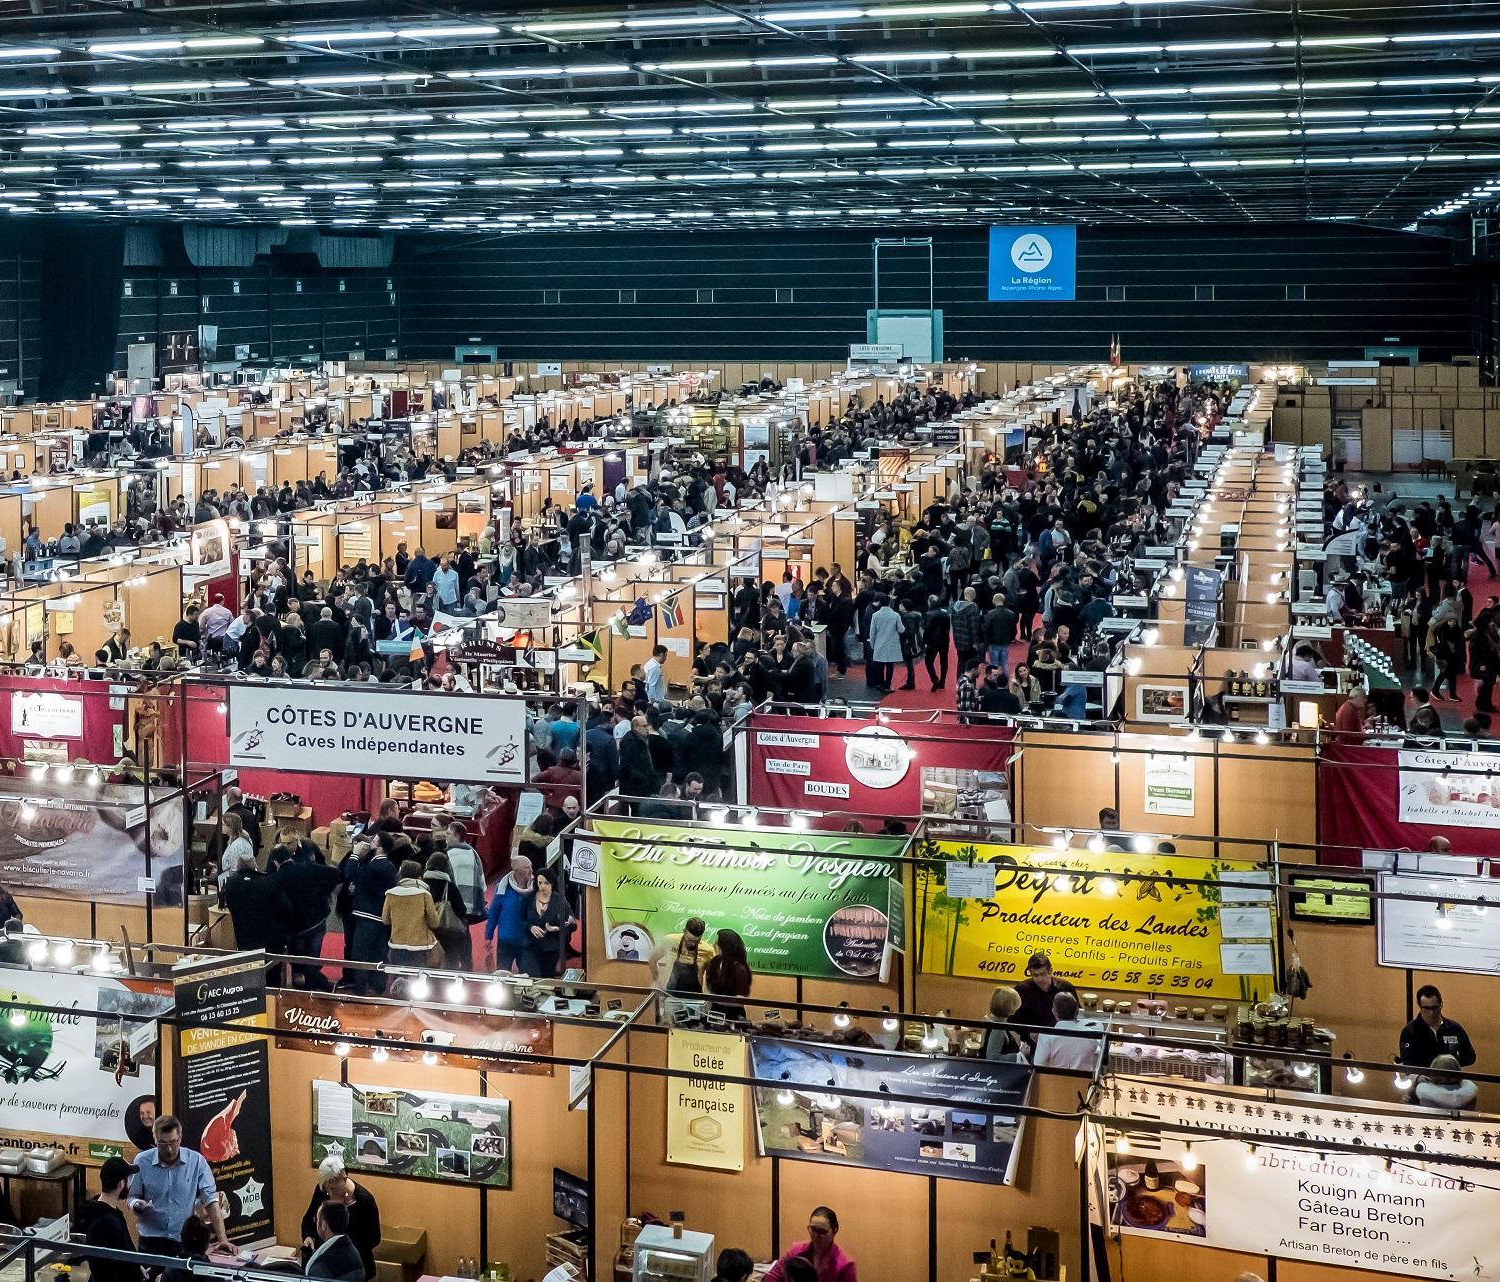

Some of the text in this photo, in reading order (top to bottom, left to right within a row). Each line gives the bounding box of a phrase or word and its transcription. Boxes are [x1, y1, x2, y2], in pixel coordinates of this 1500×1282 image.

[1011, 276, 1052, 285] La Région
[460, 640, 502, 652] RHUMS
[266, 704, 484, 735] CÔTES D'AUVERGNE
[285, 732, 466, 756] Caves Indépendantes
[759, 732, 816, 745] Côtes d'Auvergne
[768, 760, 810, 771] Vin de Pays
[1414, 755, 1448, 765] Côtes
[807, 783, 848, 796] BOUDES
[1407, 806, 1439, 814] Isabelle
[1452, 809, 1482, 817] Michel
[610, 828, 896, 890] Au Fumoir Vosgien
[1071, 858, 1090, 870] chez
[615, 873, 676, 891] spécialités
[679, 880, 728, 894] maison
[727, 879, 776, 902] fumées
[779, 888, 798, 899] au
[792, 886, 823, 905] feu
[823, 889, 843, 902] de
[661, 900, 686, 914] Filet
[686, 906, 726, 917] mignon
[780, 914, 824, 928] jambon
[981, 902, 1211, 939] Producteur des Landes
[770, 930, 810, 944] paysan
[1015, 930, 1174, 954] Conserves Traditionnelles
[753, 946, 790, 956] couteau
[987, 942, 1204, 969] Foies Gras Confits Produits Frais
[977, 959, 1214, 990] 40180 05 58 55 33 04
[222, 985, 244, 996] Augros
[200, 1013, 208, 1022] 06
[209, 1012, 216, 1021] 15
[216, 1010, 225, 1019] 60
[225, 1008, 232, 1016] 15
[232, 1006, 240, 1015] 25
[284, 1008, 342, 1030] Viande
[190, 1026, 219, 1041] VENTE
[187, 1036, 239, 1054] DE VIANDE EN
[681, 1038, 732, 1054] Producteur de
[692, 1053, 725, 1070] Gelée
[7, 1093, 20, 1108] de
[21, 1097, 59, 1112] saveurs
[59, 1102, 121, 1120] provençales
[678, 1094, 735, 1113] Française
[242, 1192, 261, 1204] MDB
[1298, 1179, 1426, 1208] Kouign Amann
[1298, 1198, 1425, 1228] Gâteau Breton
[1299, 1217, 1390, 1243] Far Breton
[1279, 1237, 1449, 1270] Artisan Breton de père en fils
